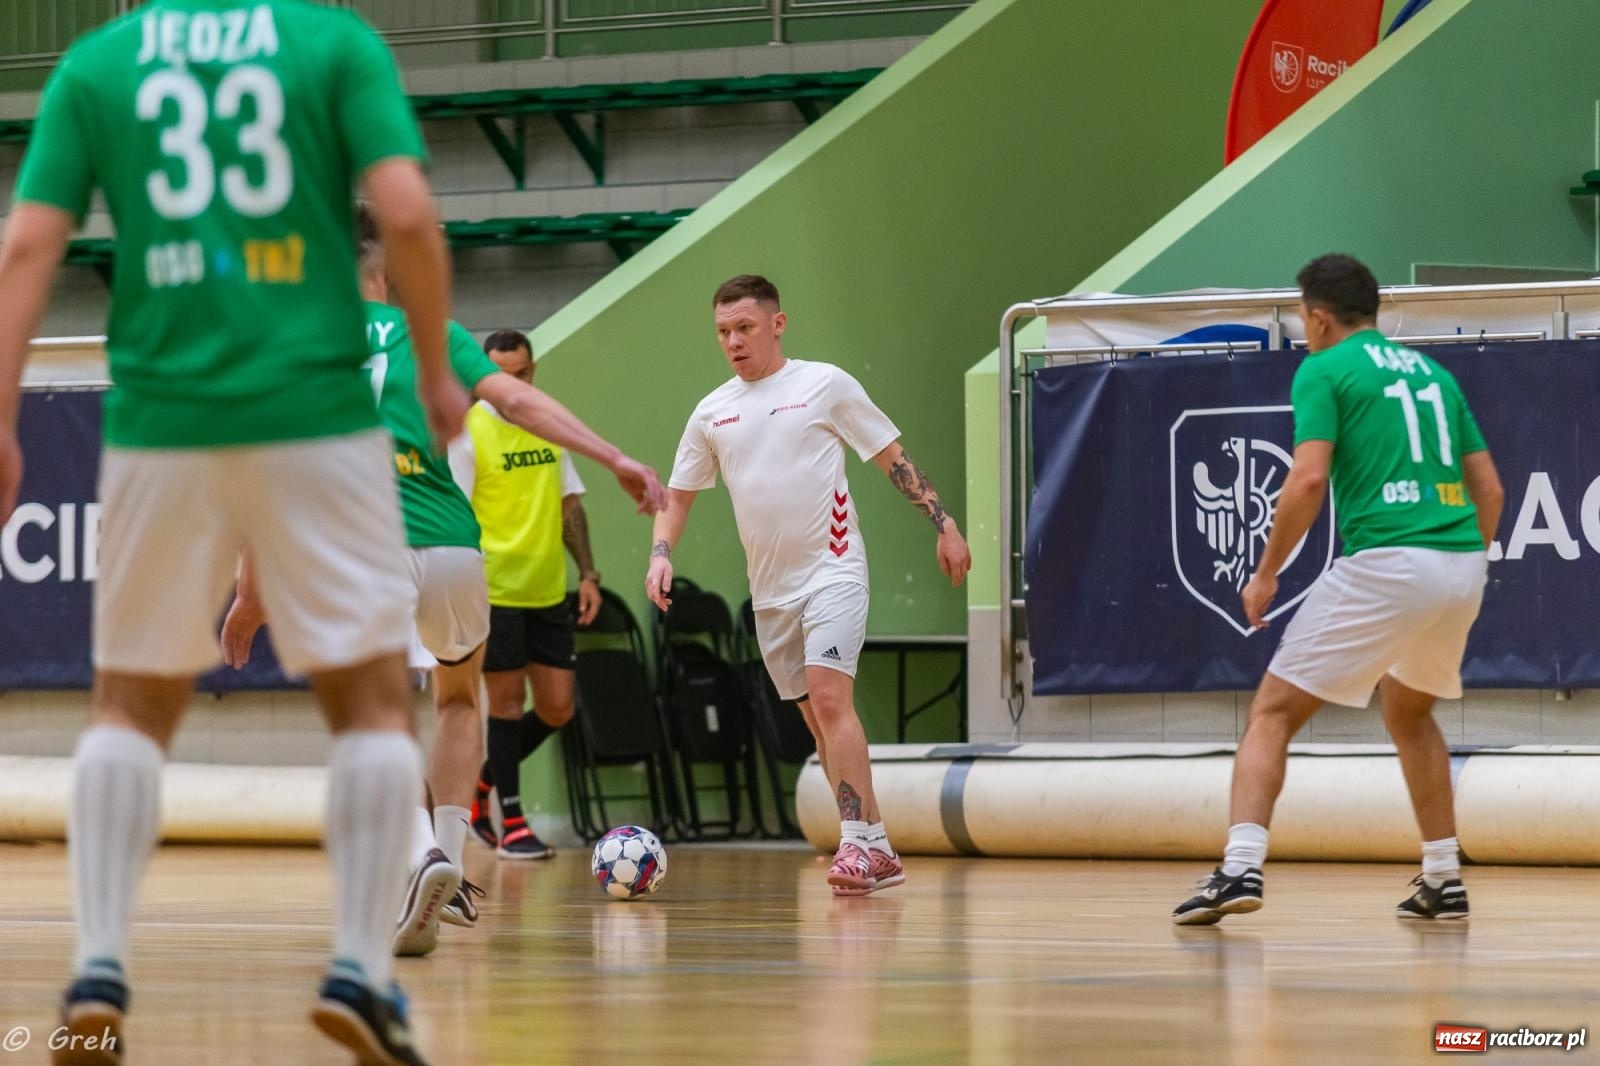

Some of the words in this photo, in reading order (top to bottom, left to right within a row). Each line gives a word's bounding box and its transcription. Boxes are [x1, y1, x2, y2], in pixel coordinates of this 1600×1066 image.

[135, 64, 295, 221] 33
[712, 414, 740, 428] hummel
[1384, 379, 1453, 466] 11
